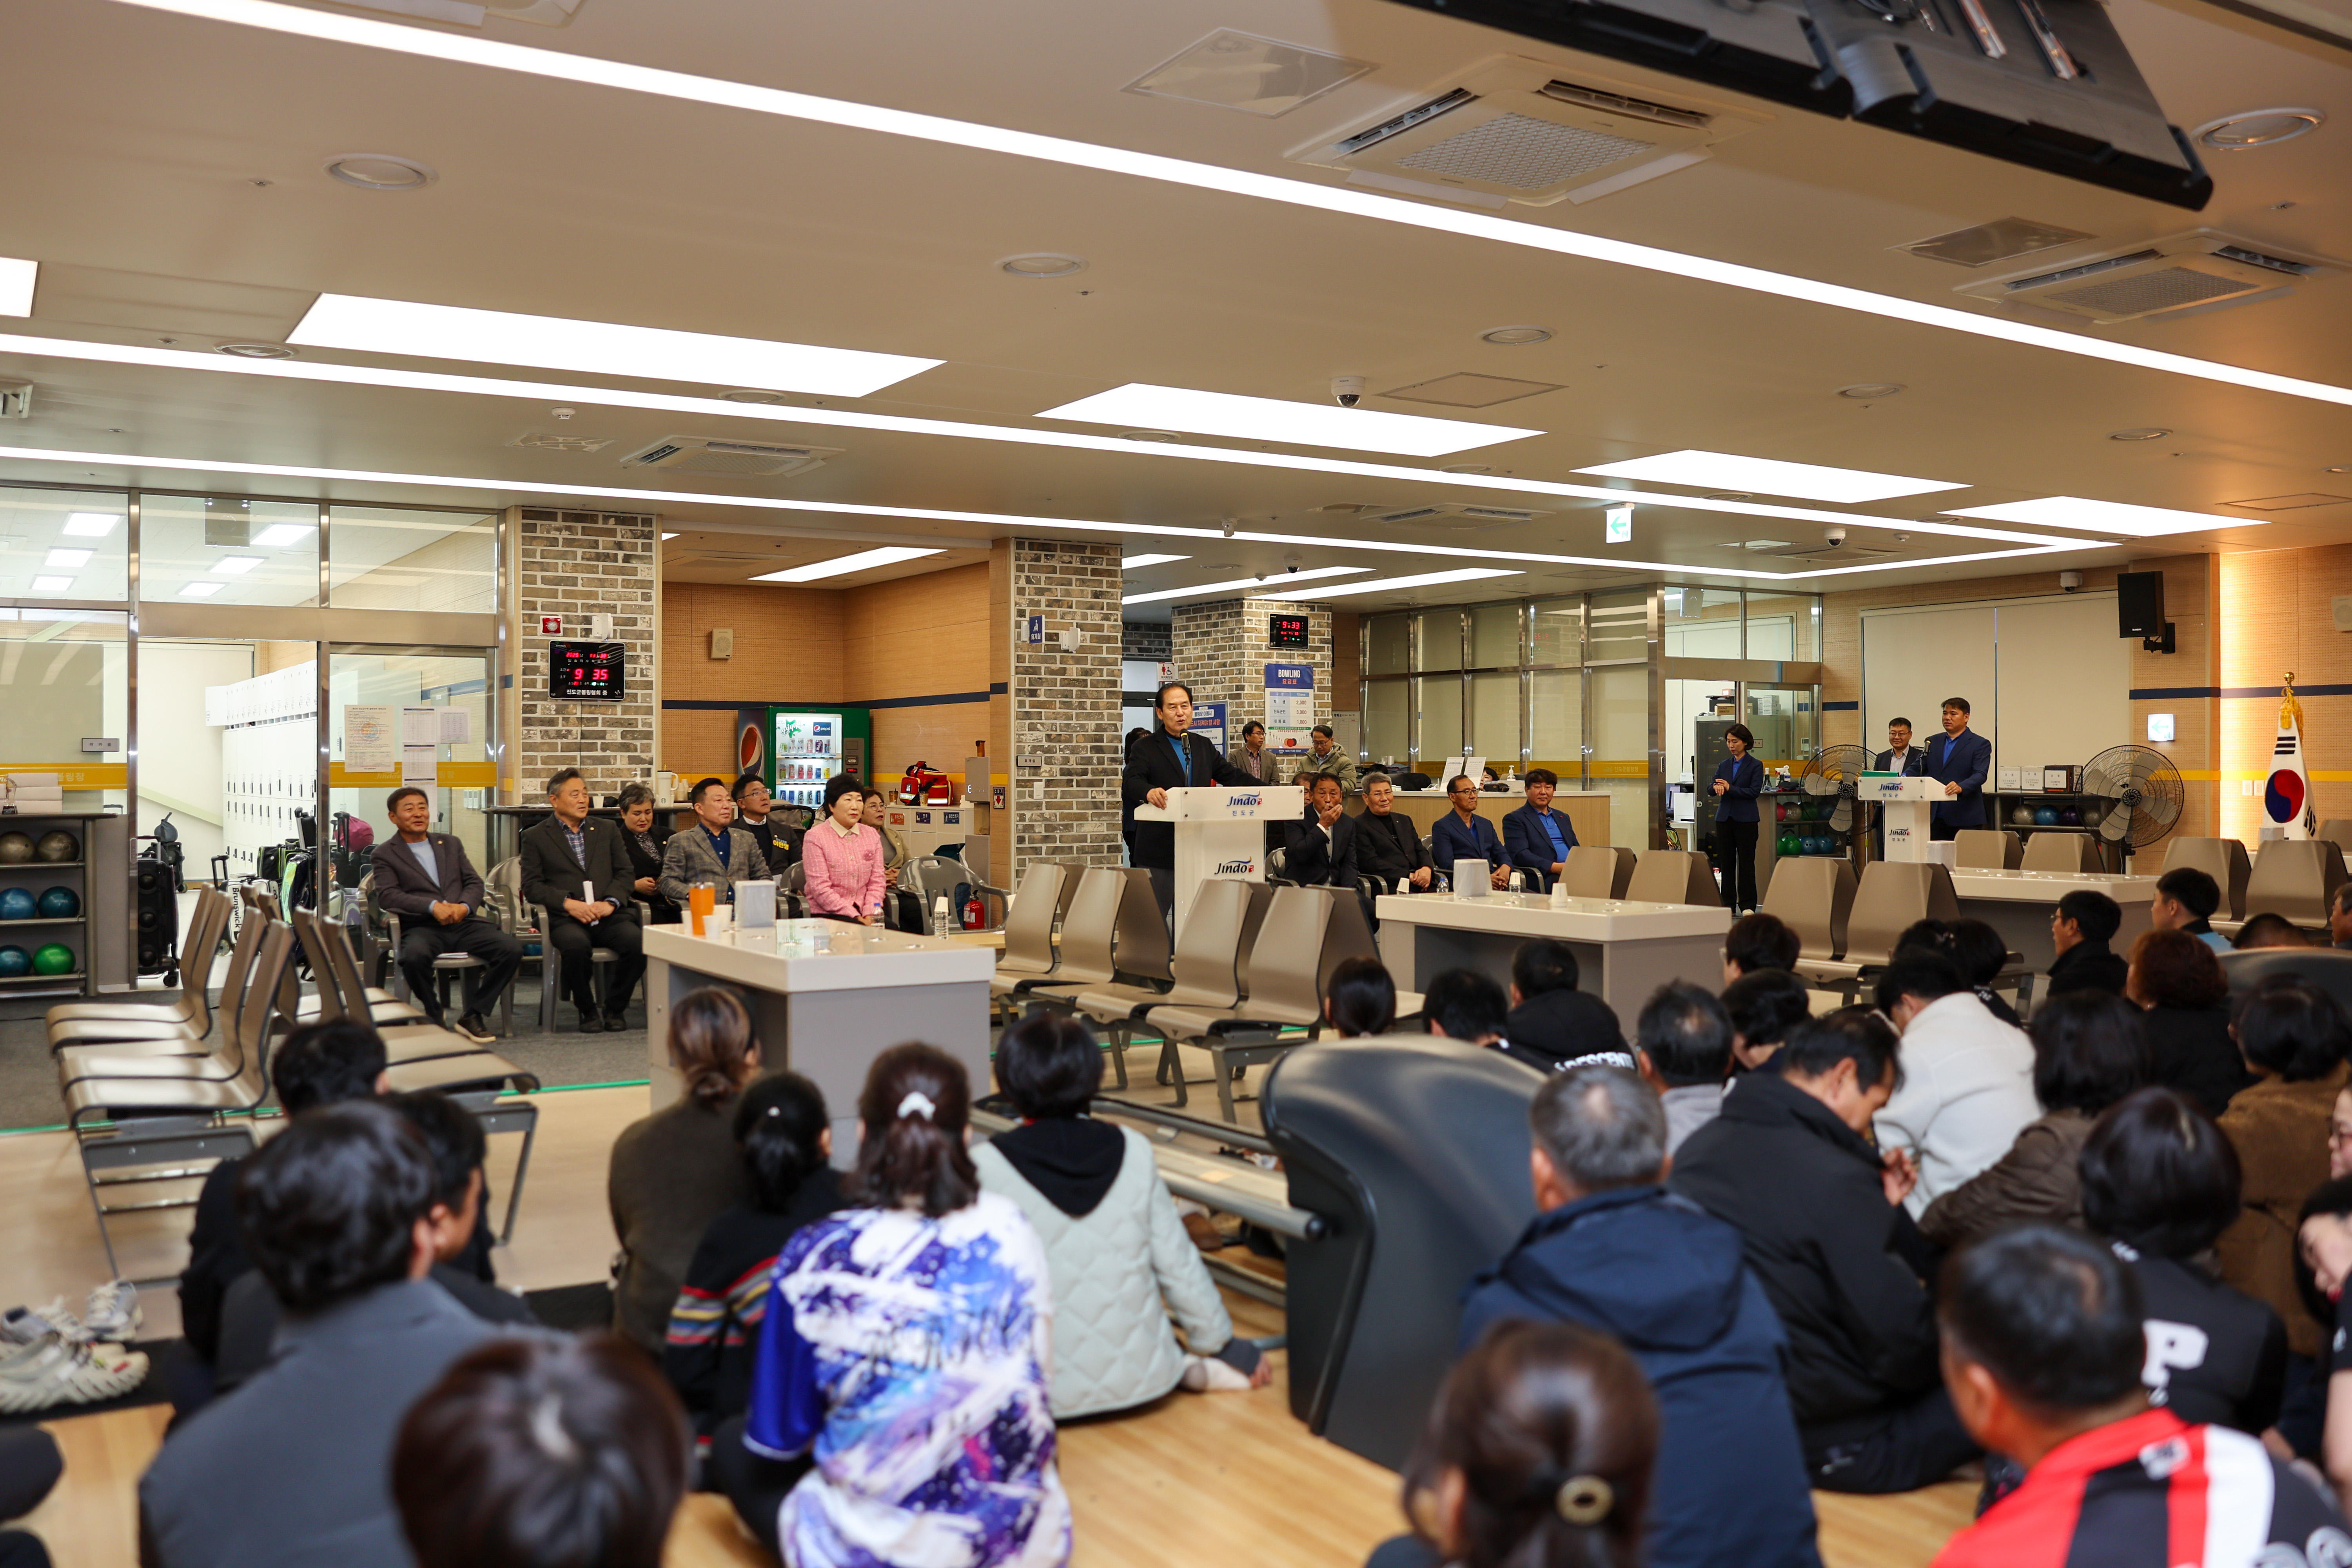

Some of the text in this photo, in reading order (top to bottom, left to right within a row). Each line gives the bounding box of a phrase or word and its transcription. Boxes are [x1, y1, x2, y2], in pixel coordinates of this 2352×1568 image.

[574, 668, 608, 680] 9 35
[1278, 669, 1301, 678] BOWLING
[1227, 796, 1256, 806] Jindo
[1214, 862, 1247, 875] Jindo
[232, 887, 242, 929] Brunswick
